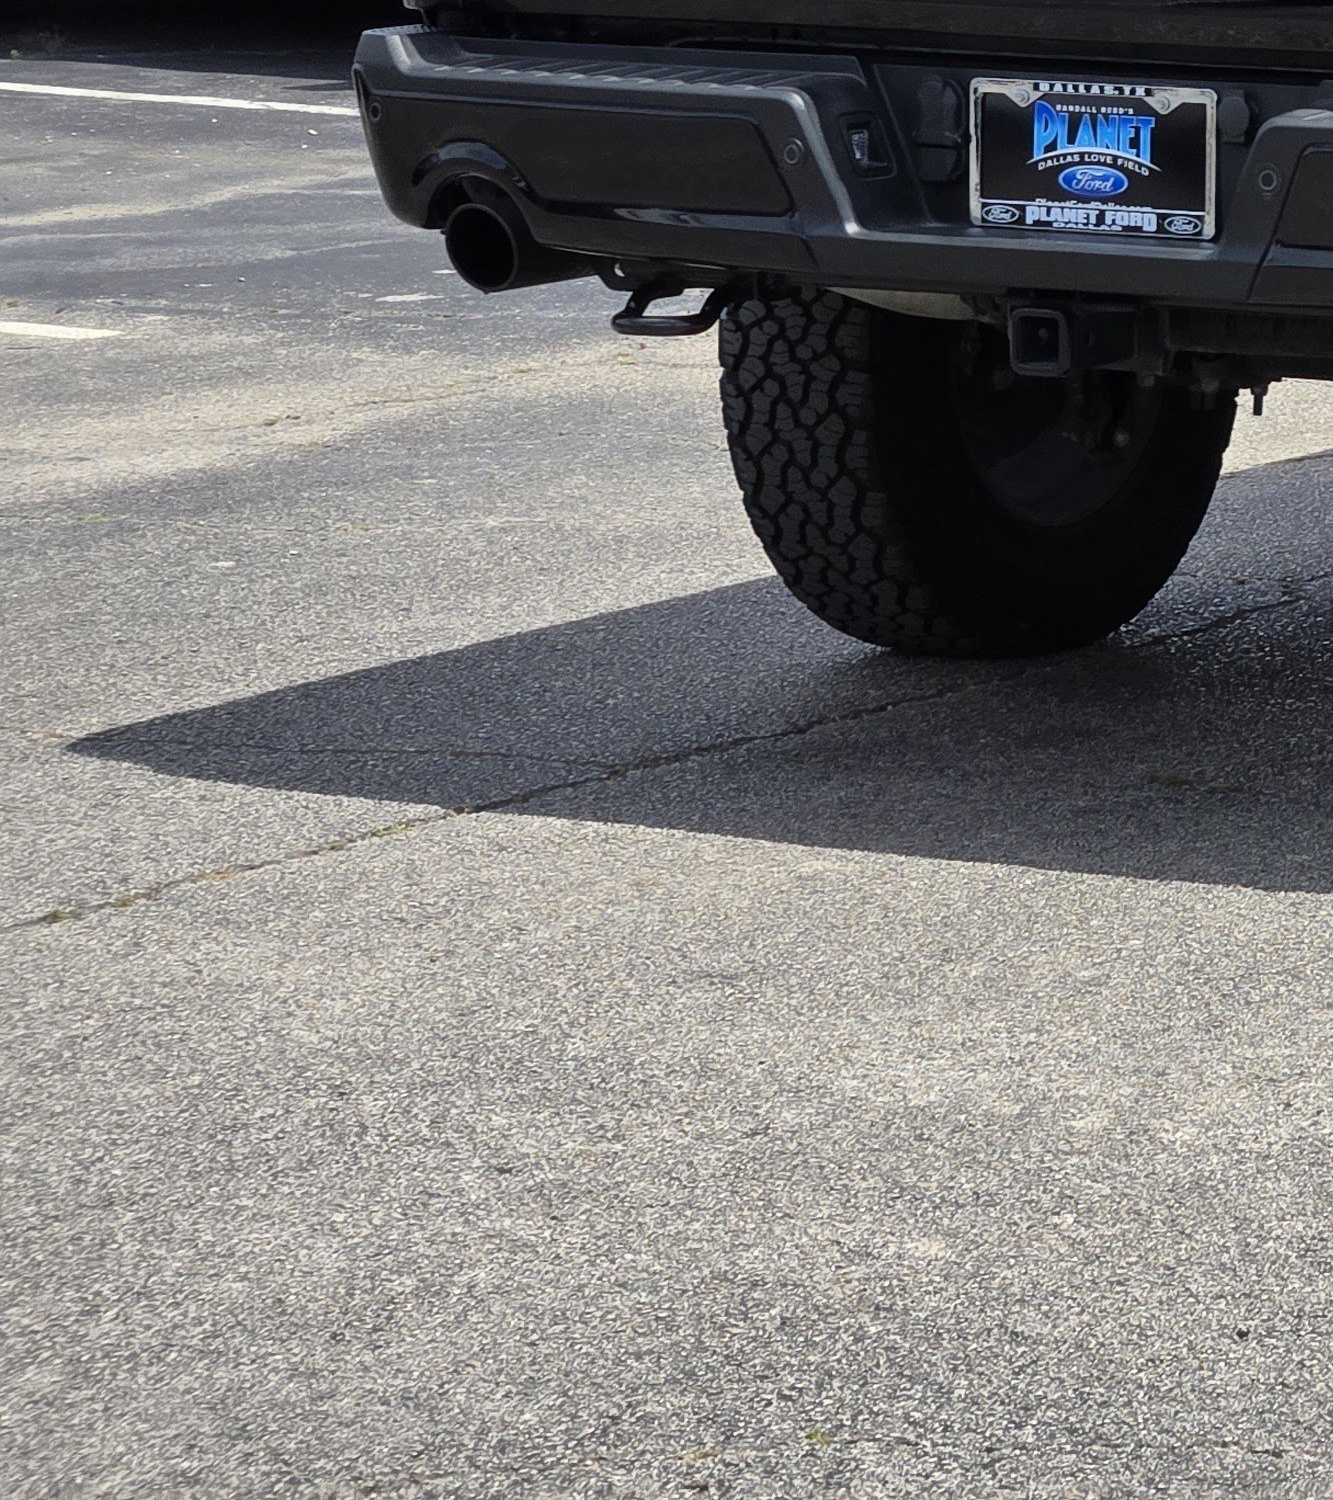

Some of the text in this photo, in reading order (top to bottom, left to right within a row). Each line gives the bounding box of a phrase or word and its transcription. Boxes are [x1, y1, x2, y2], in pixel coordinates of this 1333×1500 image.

[1033, 99, 1156, 164] PLANET
[1037, 153, 1150, 177] DALLAS LOVE FIELD
[1071, 169, 1115, 194] Ford
[1025, 205, 1158, 233] PLANET FORD
[1052, 221, 1123, 231] DALLAS
